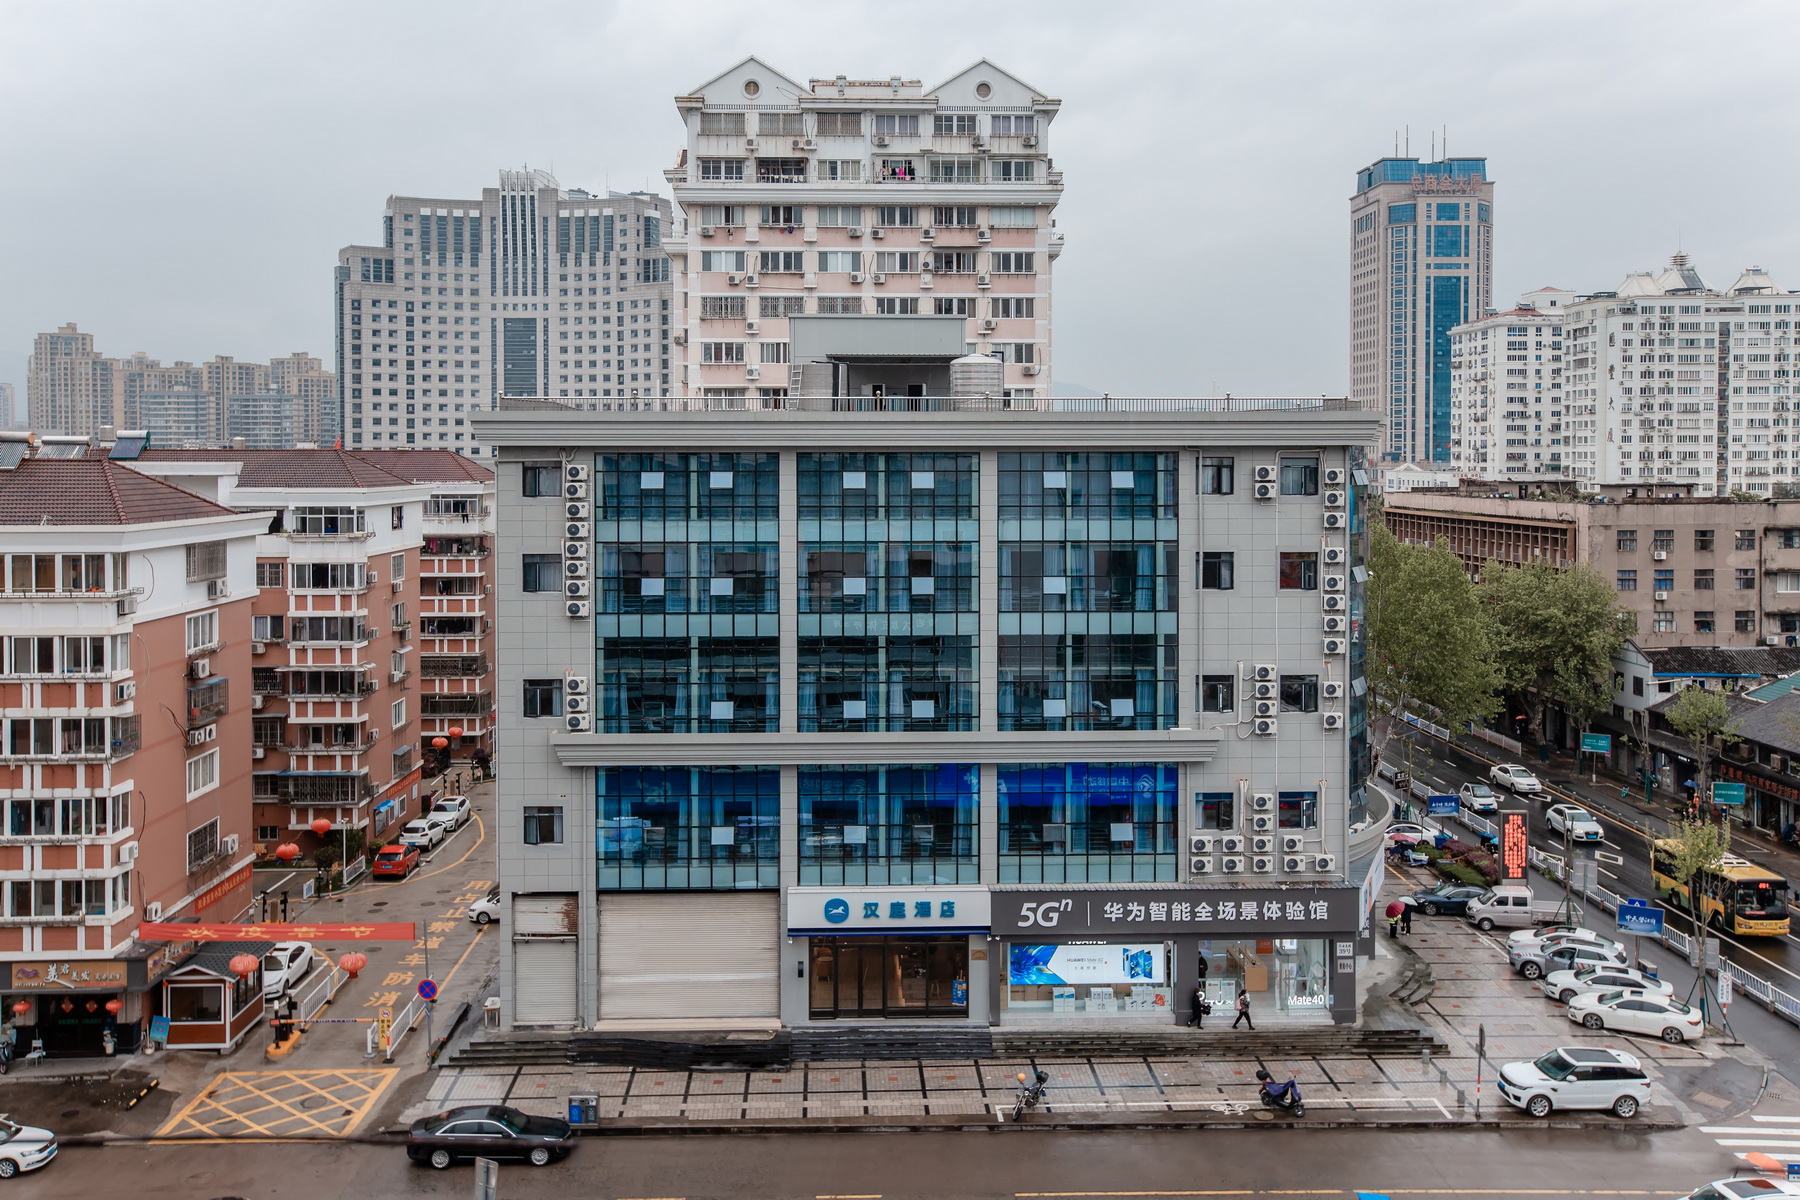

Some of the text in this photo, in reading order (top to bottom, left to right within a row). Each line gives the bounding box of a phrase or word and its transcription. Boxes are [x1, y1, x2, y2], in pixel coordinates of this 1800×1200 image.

[1409, 173, 1483, 192] 总商会大厦
[863, 901, 956, 919] 汉庭酒店
[1103, 900, 1329, 921] 华为智能全场景体验馆
[182, 926, 376, 938] 欢度春节
[1287, 994, 1325, 1005] Mate40
